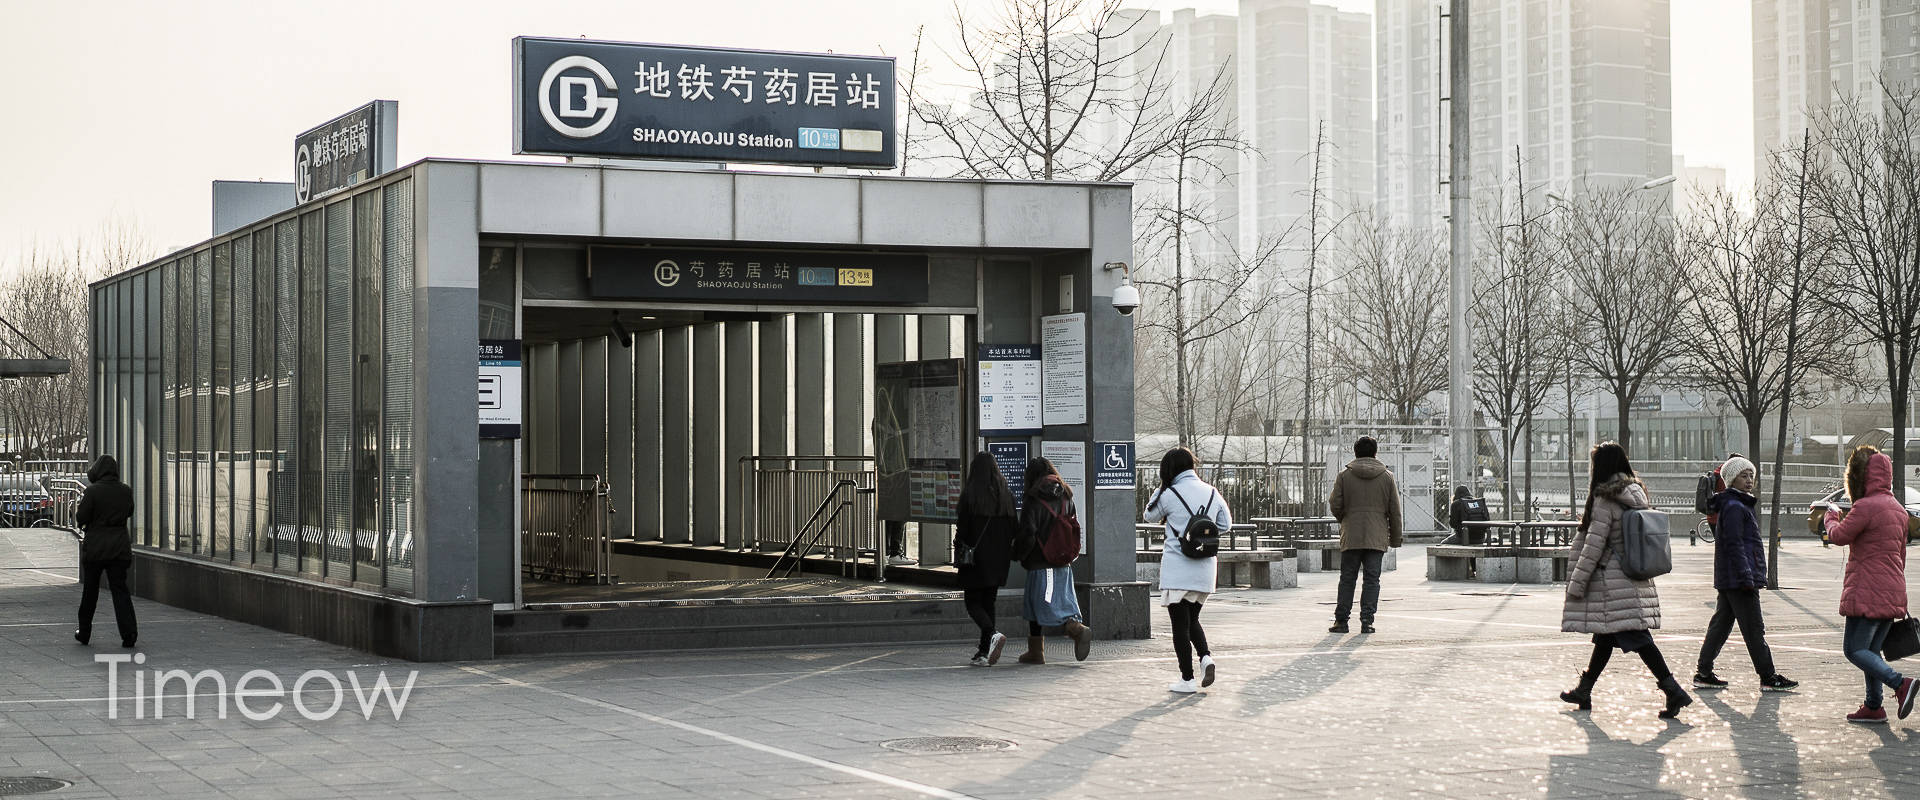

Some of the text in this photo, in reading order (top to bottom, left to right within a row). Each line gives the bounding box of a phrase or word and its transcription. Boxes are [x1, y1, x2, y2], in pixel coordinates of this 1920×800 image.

[633, 61, 881, 110] 地铁芍药居站
[313, 118, 368, 168] 地铁芍药居站
[632, 127, 793, 149] SHAOYAOJU Station
[688, 260, 790, 279] 芍药居站
[800, 269, 815, 284] 10
[697, 280, 783, 290] SHAOYAOJU Station
